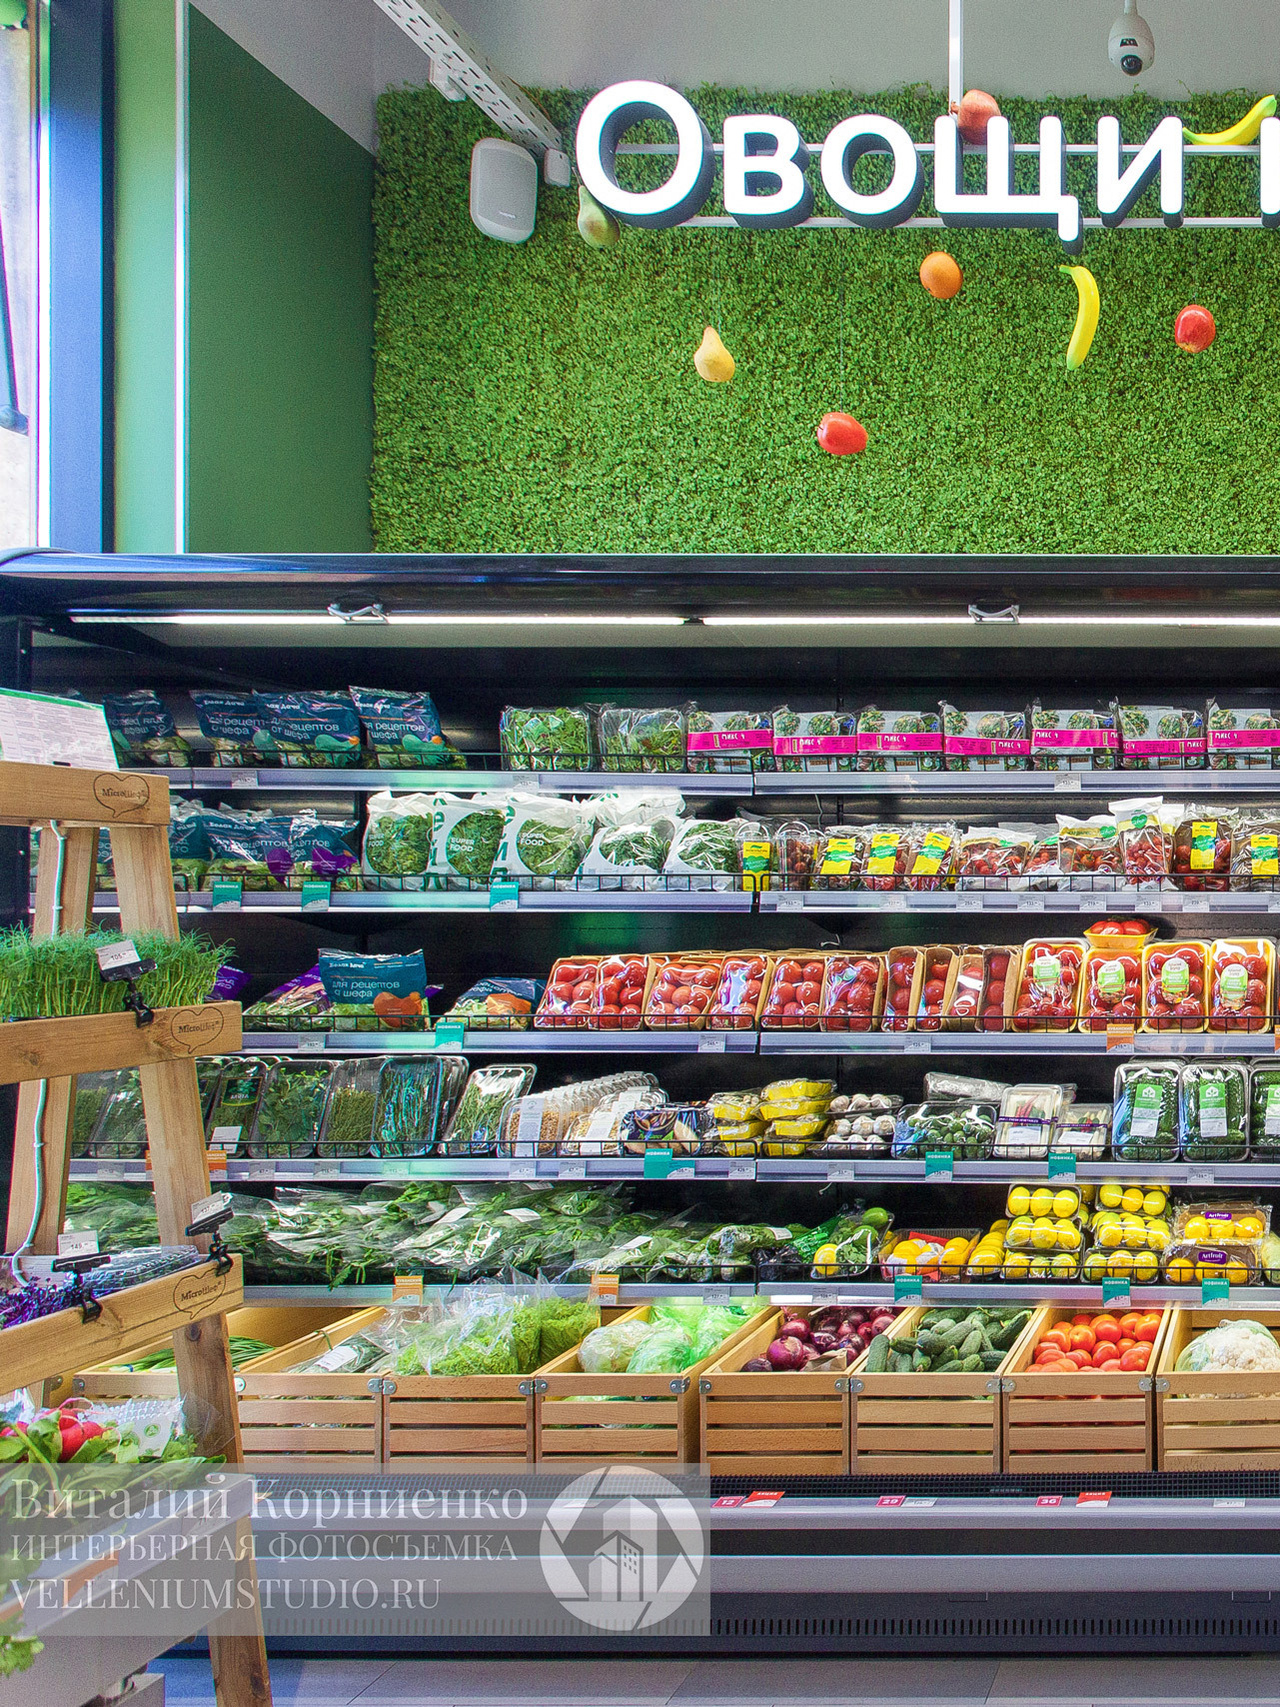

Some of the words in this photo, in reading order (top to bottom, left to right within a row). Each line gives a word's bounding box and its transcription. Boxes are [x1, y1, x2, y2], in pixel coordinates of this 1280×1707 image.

[576, 80, 1186, 246] Овощи
[450, 837, 475, 846] SUPER
[450, 844, 474, 853] FOOD
[352, 980, 401, 991] рецептов
[1202, 1252, 1223, 1260] Artfruit
